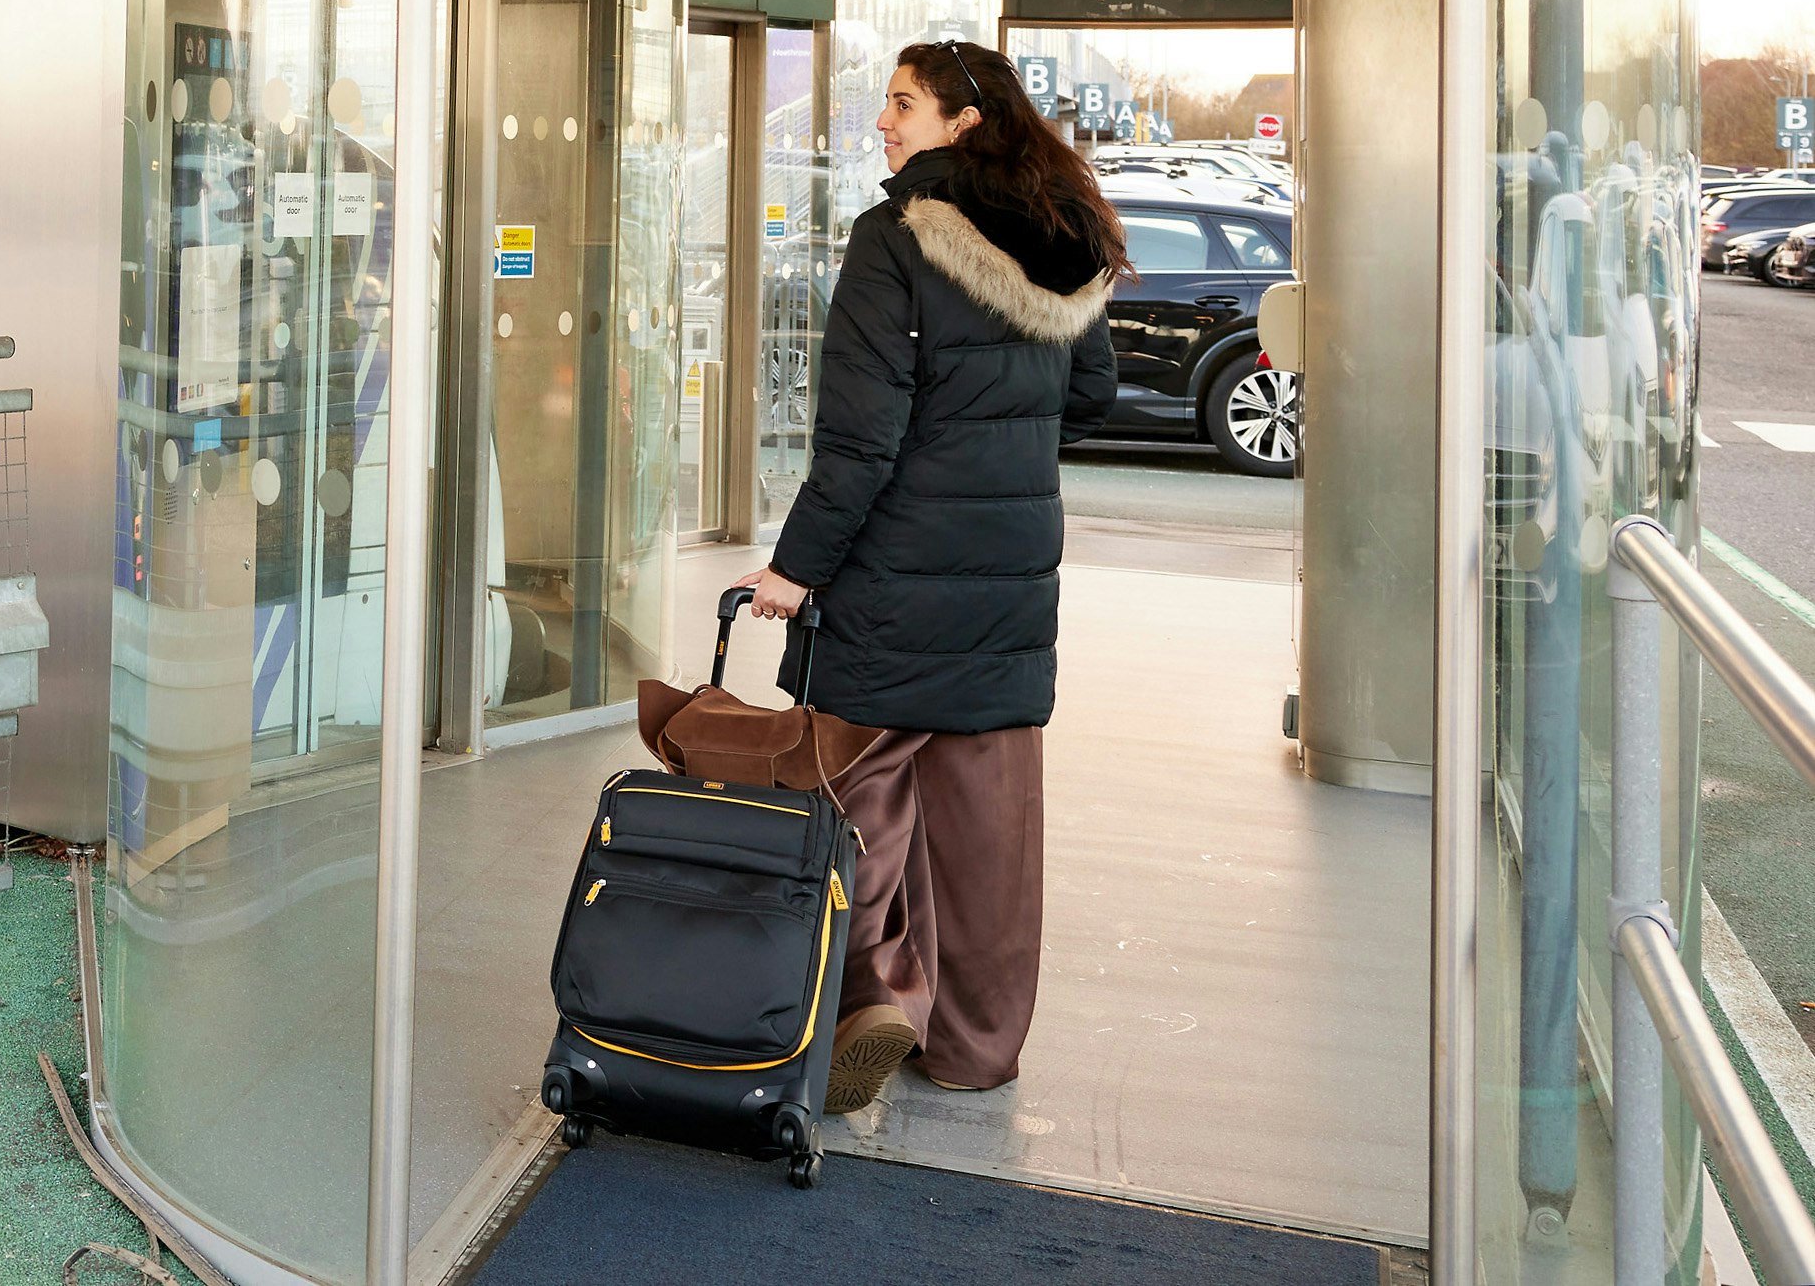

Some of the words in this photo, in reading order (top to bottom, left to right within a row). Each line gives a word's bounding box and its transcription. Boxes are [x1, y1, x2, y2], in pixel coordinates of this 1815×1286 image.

[1025, 64, 1049, 94] B
[1085, 88, 1104, 112] B
[1041, 104, 1052, 117] 7
[1116, 104, 1136, 124] A
[1785, 103, 1807, 129] B
[1082, 118, 1091, 128] 6
[1097, 118, 1105, 128] 7
[1159, 122, 1173, 138] A
[1781, 136, 1792, 148] 8
[1799, 136, 1810, 148] 9
[278, 194, 309, 204] Automatic
[338, 194, 366, 203] Automatic
[286, 207, 301, 215] door
[344, 206, 358, 214] door
[832, 880, 845, 905] EXPAND
